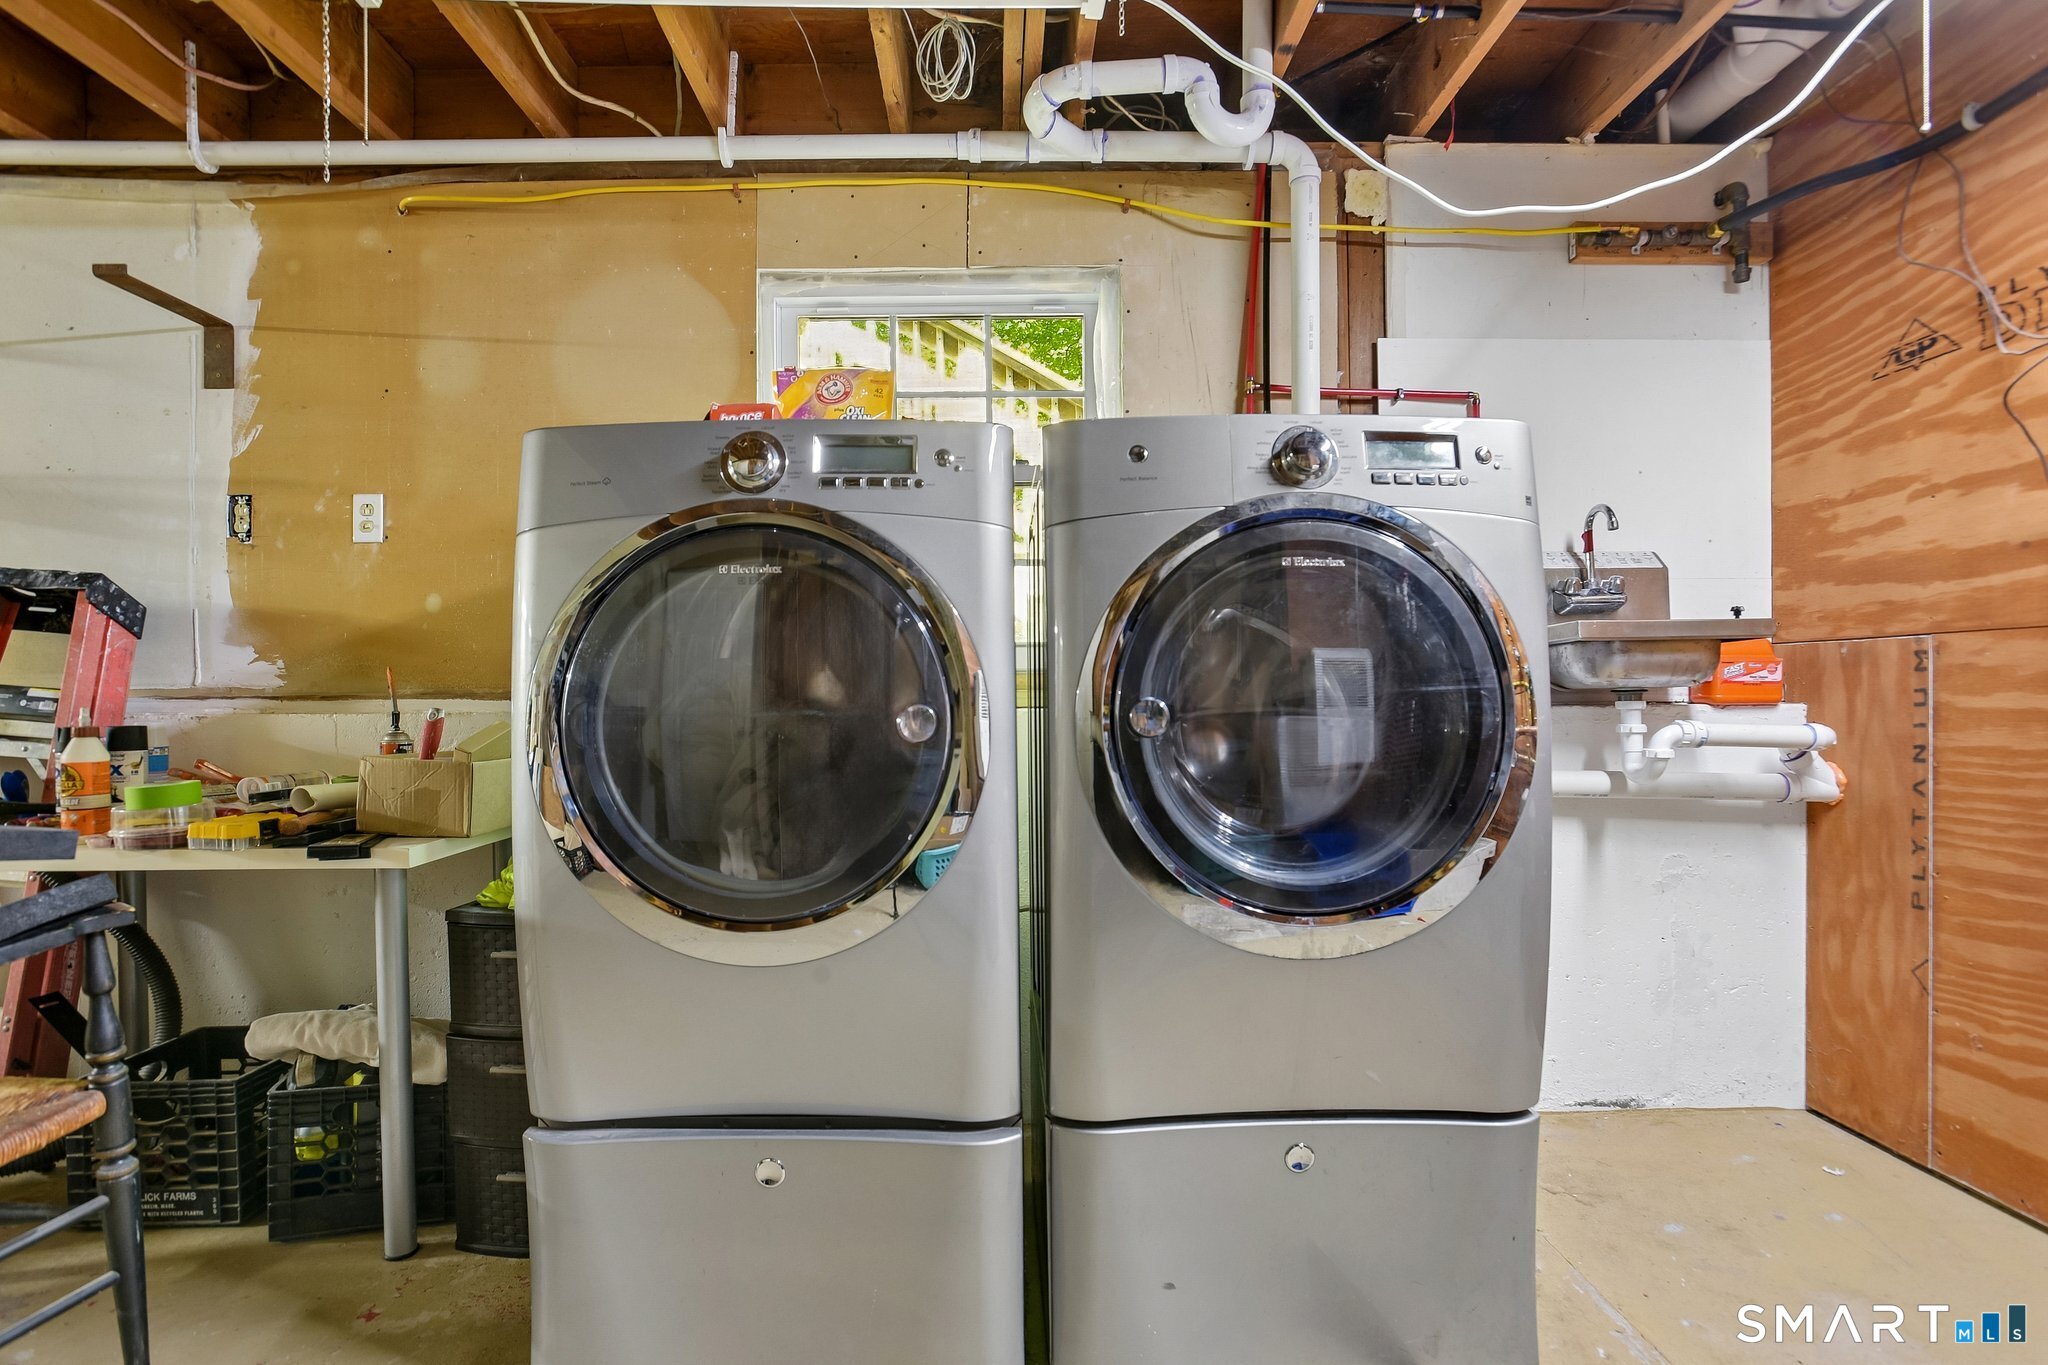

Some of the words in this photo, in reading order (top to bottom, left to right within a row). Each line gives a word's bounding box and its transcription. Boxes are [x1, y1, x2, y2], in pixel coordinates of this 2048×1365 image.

[845, 405, 865, 415] OXI
[1293, 556, 1346, 567] Electrolux
[730, 563, 783, 574] Electrolux
[1724, 662, 1745, 673] FAST
[1911, 649, 1929, 911] PLYTANIUM
[163, 1191, 197, 1201] FARMS
